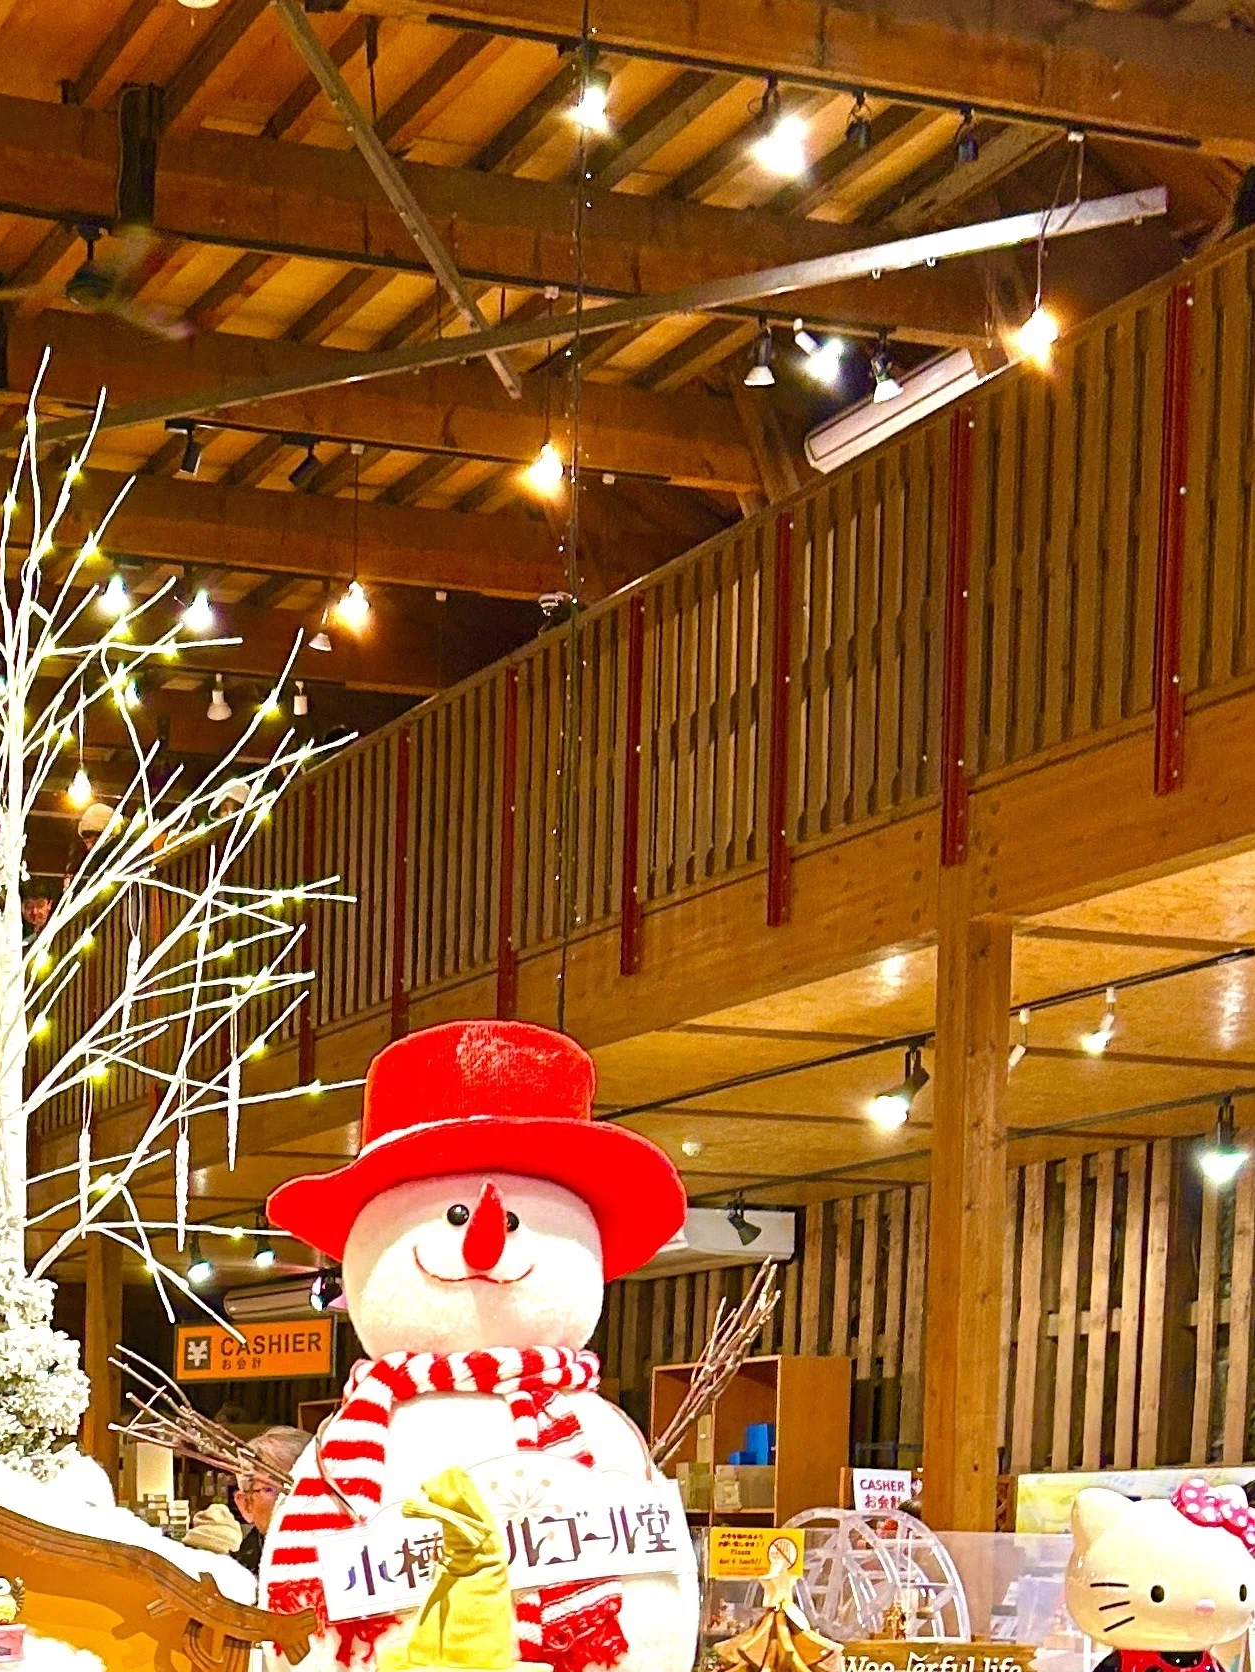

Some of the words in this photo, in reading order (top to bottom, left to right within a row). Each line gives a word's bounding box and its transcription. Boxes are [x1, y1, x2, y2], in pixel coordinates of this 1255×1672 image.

[220, 1332, 322, 1356] CASHIER
[221, 1357, 262, 1371] お会計
[859, 1479, 905, 1492] CASHER
[343, 1503, 677, 1596] 小樽ルゴール堂
